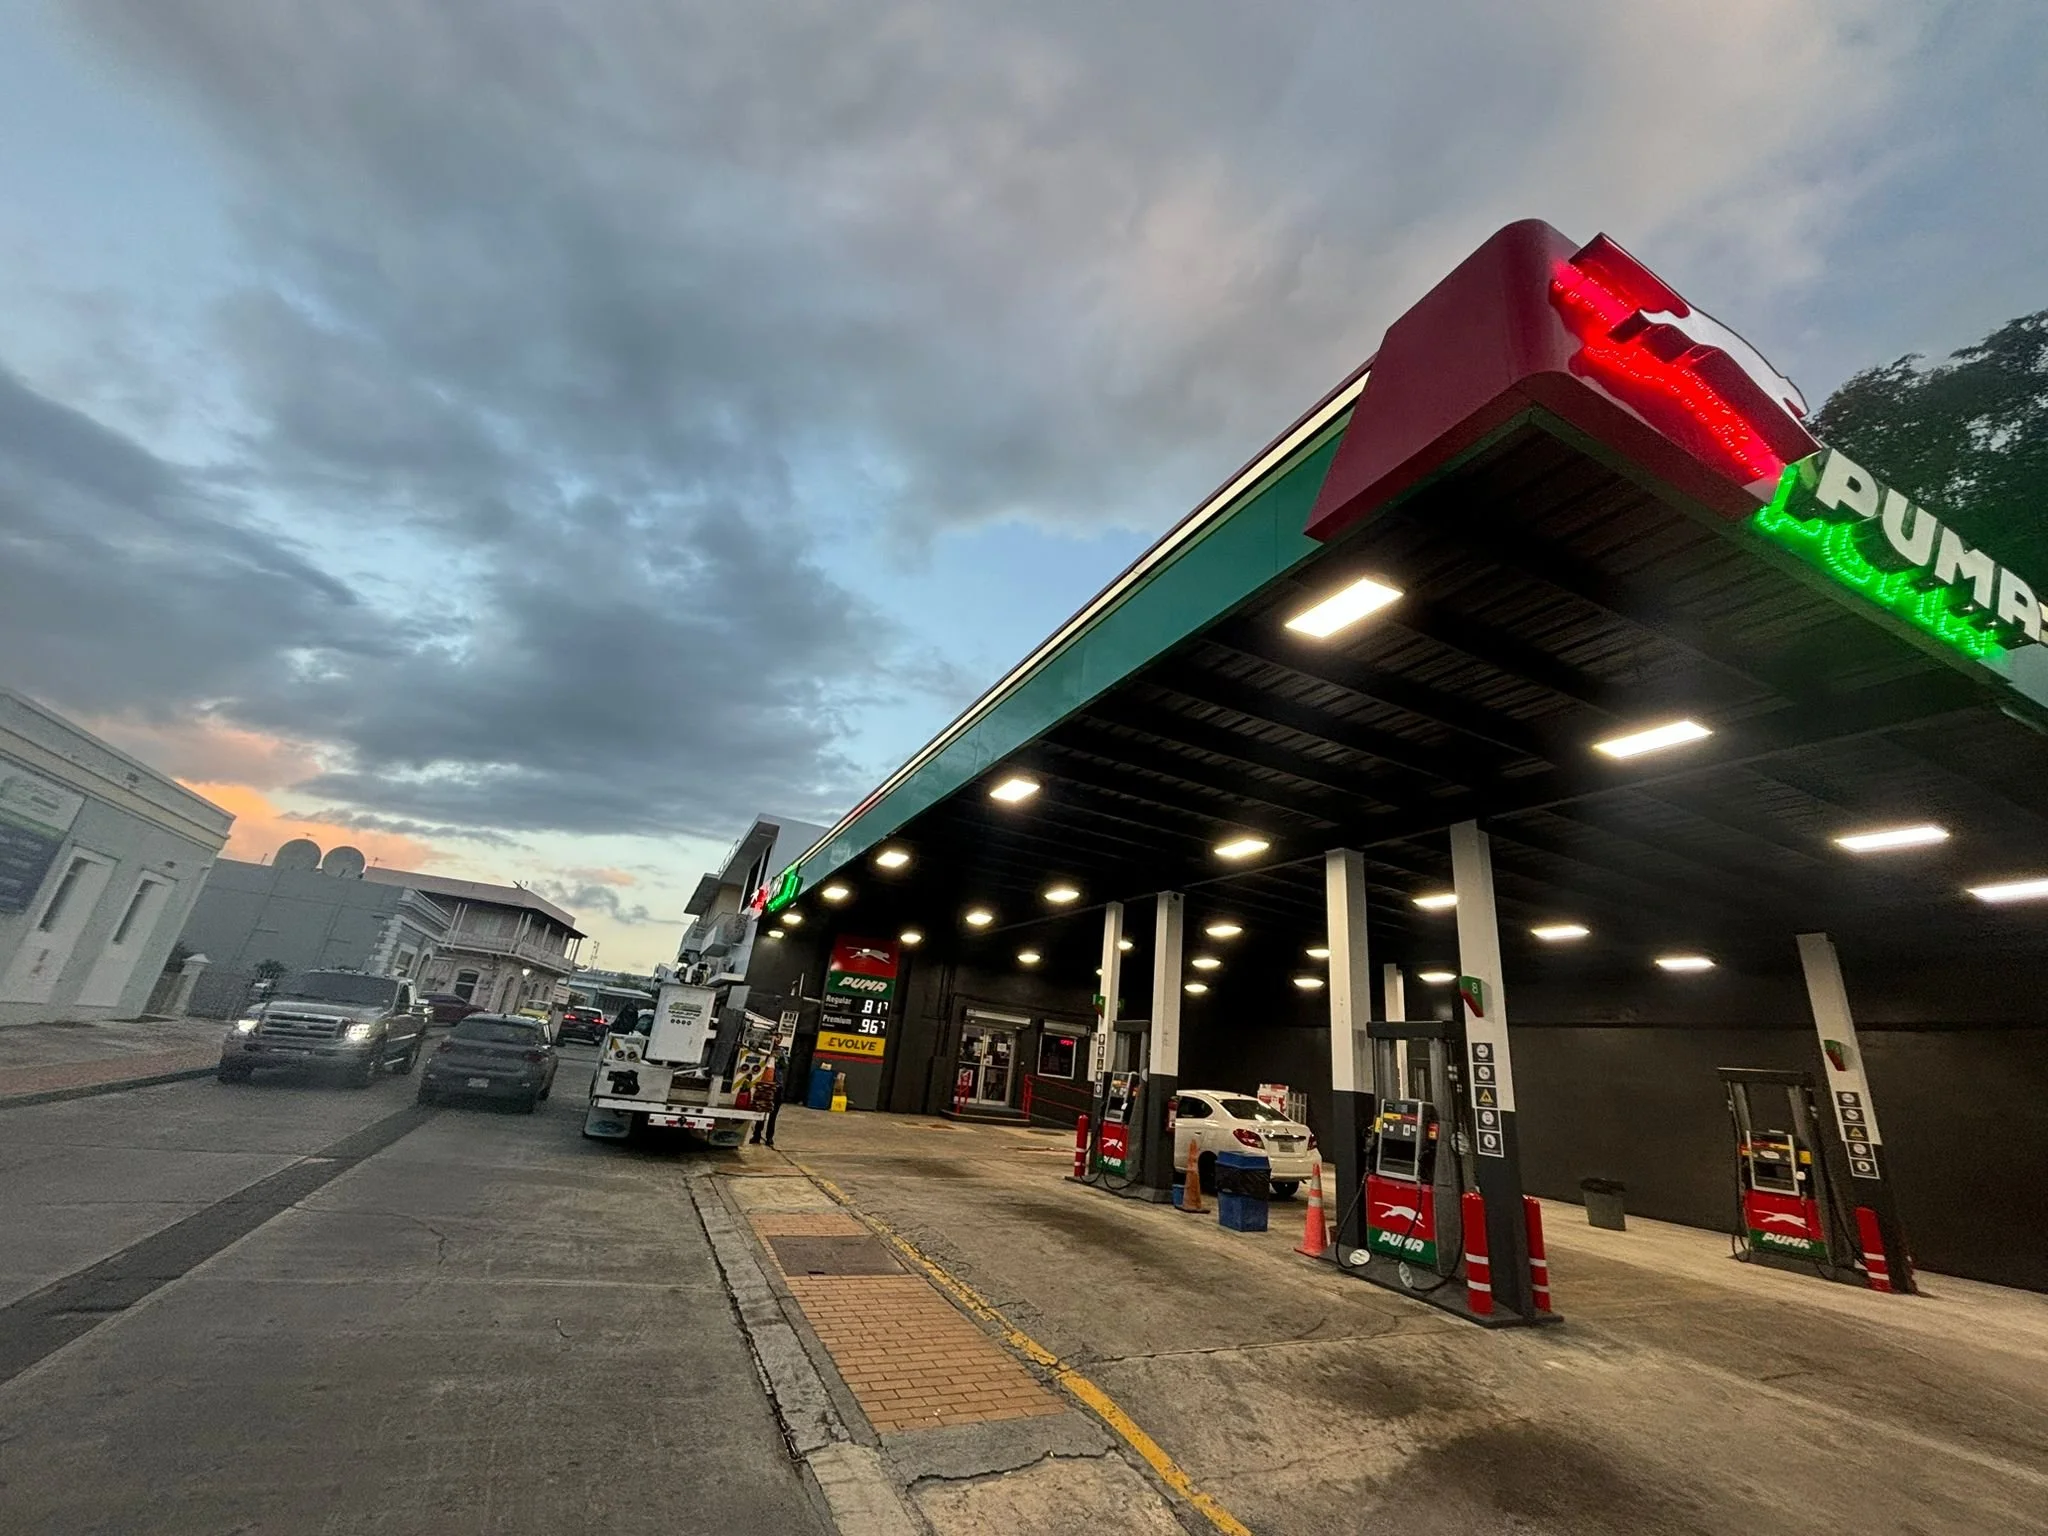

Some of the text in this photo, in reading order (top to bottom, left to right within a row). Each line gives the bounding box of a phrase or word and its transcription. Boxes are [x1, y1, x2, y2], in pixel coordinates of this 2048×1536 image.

[1815, 448, 2042, 643] PUMA
[838, 976, 887, 992] PUMA
[1471, 982, 1479, 994] 8
[826, 994, 852, 1006] Regular
[822, 1014, 852, 1025] Premium
[827, 1037, 877, 1052] EVOLVE
[1378, 1230, 1425, 1252] PUMA
